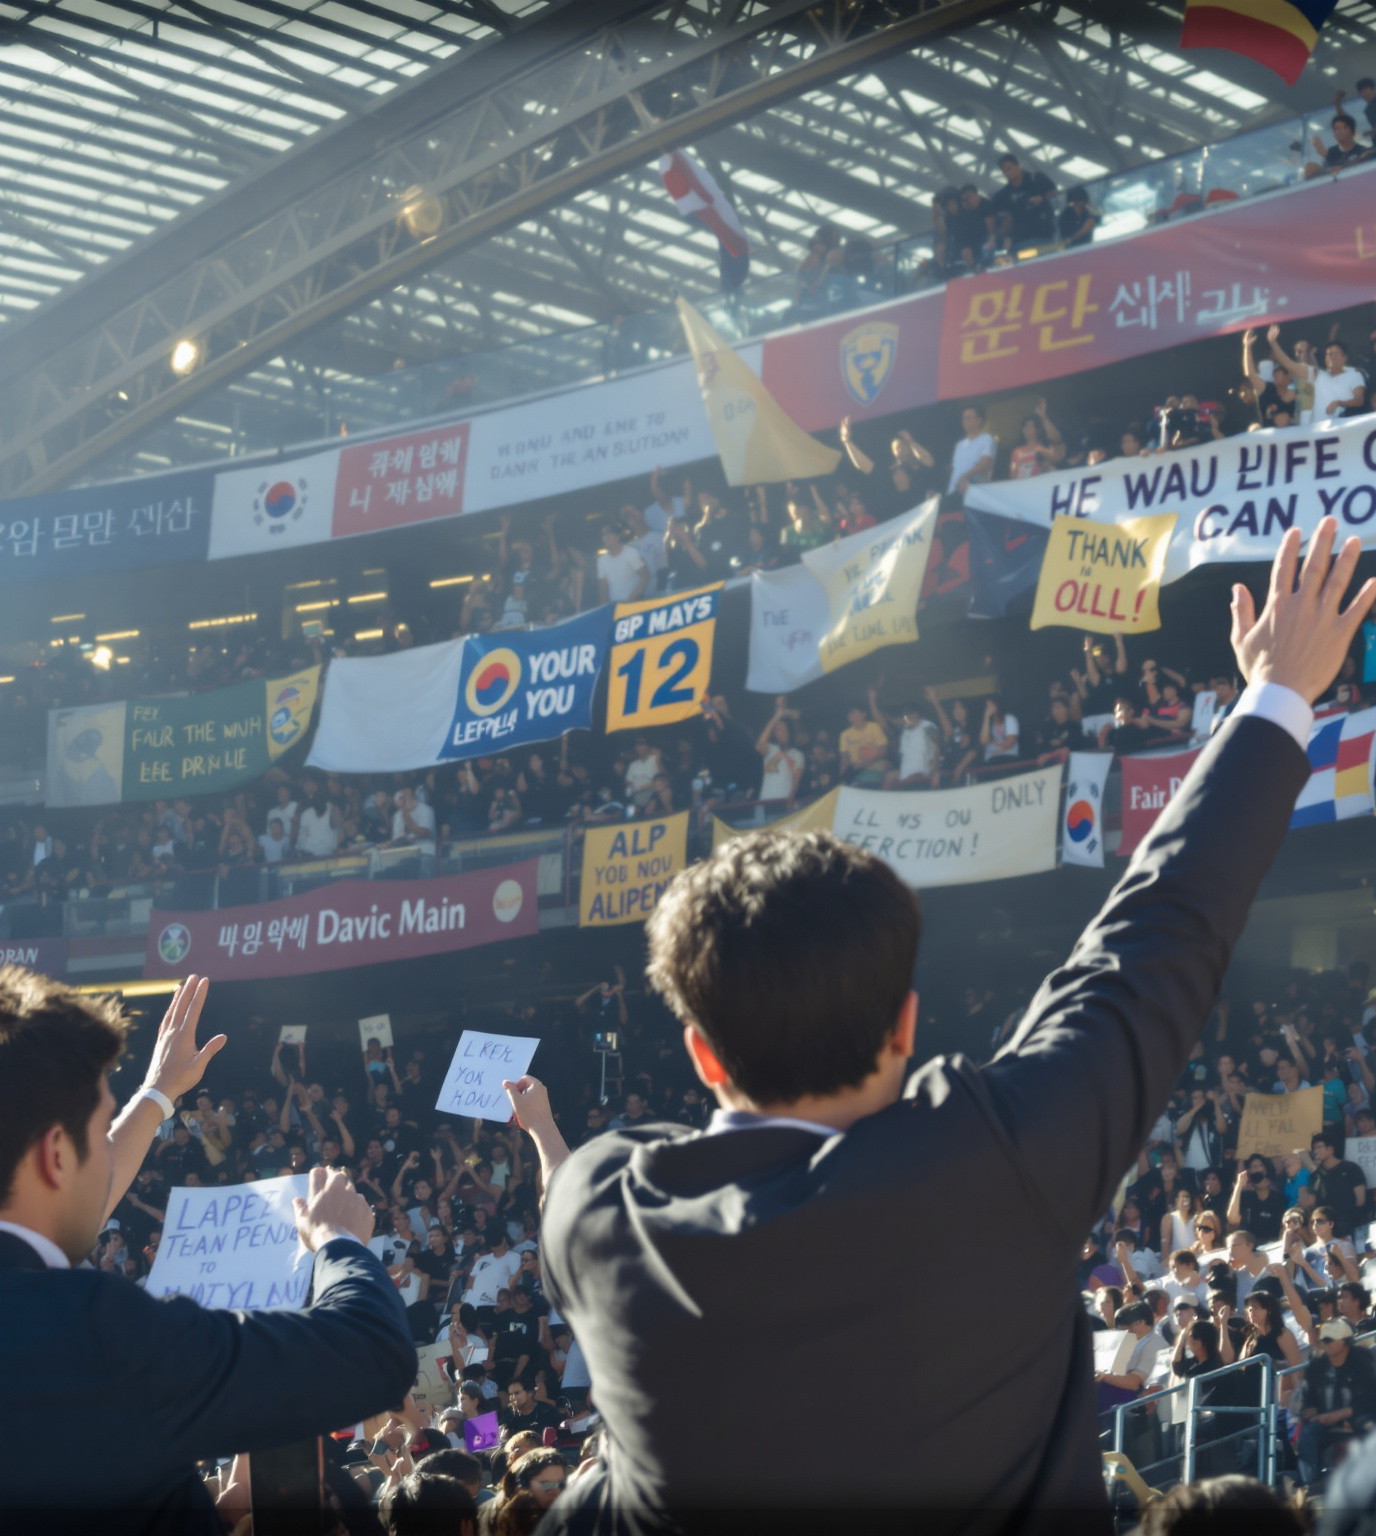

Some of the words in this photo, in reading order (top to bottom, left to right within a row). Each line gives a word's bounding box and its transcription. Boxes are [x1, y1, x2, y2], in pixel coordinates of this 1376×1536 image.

[1050, 476, 1102, 521] HE
[1123, 456, 1218, 510] WAU
[1194, 494, 1298, 541] CAN
[1067, 530, 1149, 568] THANK
[648, 595, 713, 635] MAYS
[529, 643, 597, 684] YOUR
[617, 637, 700, 718] 12
[525, 684, 576, 721] YOU
[182, 721, 216, 743] THE
[1129, 784, 1166, 811] Fair
[608, 823, 667, 859] ALP
[317, 903, 391, 945] Davic
[398, 896, 466, 936] Main
